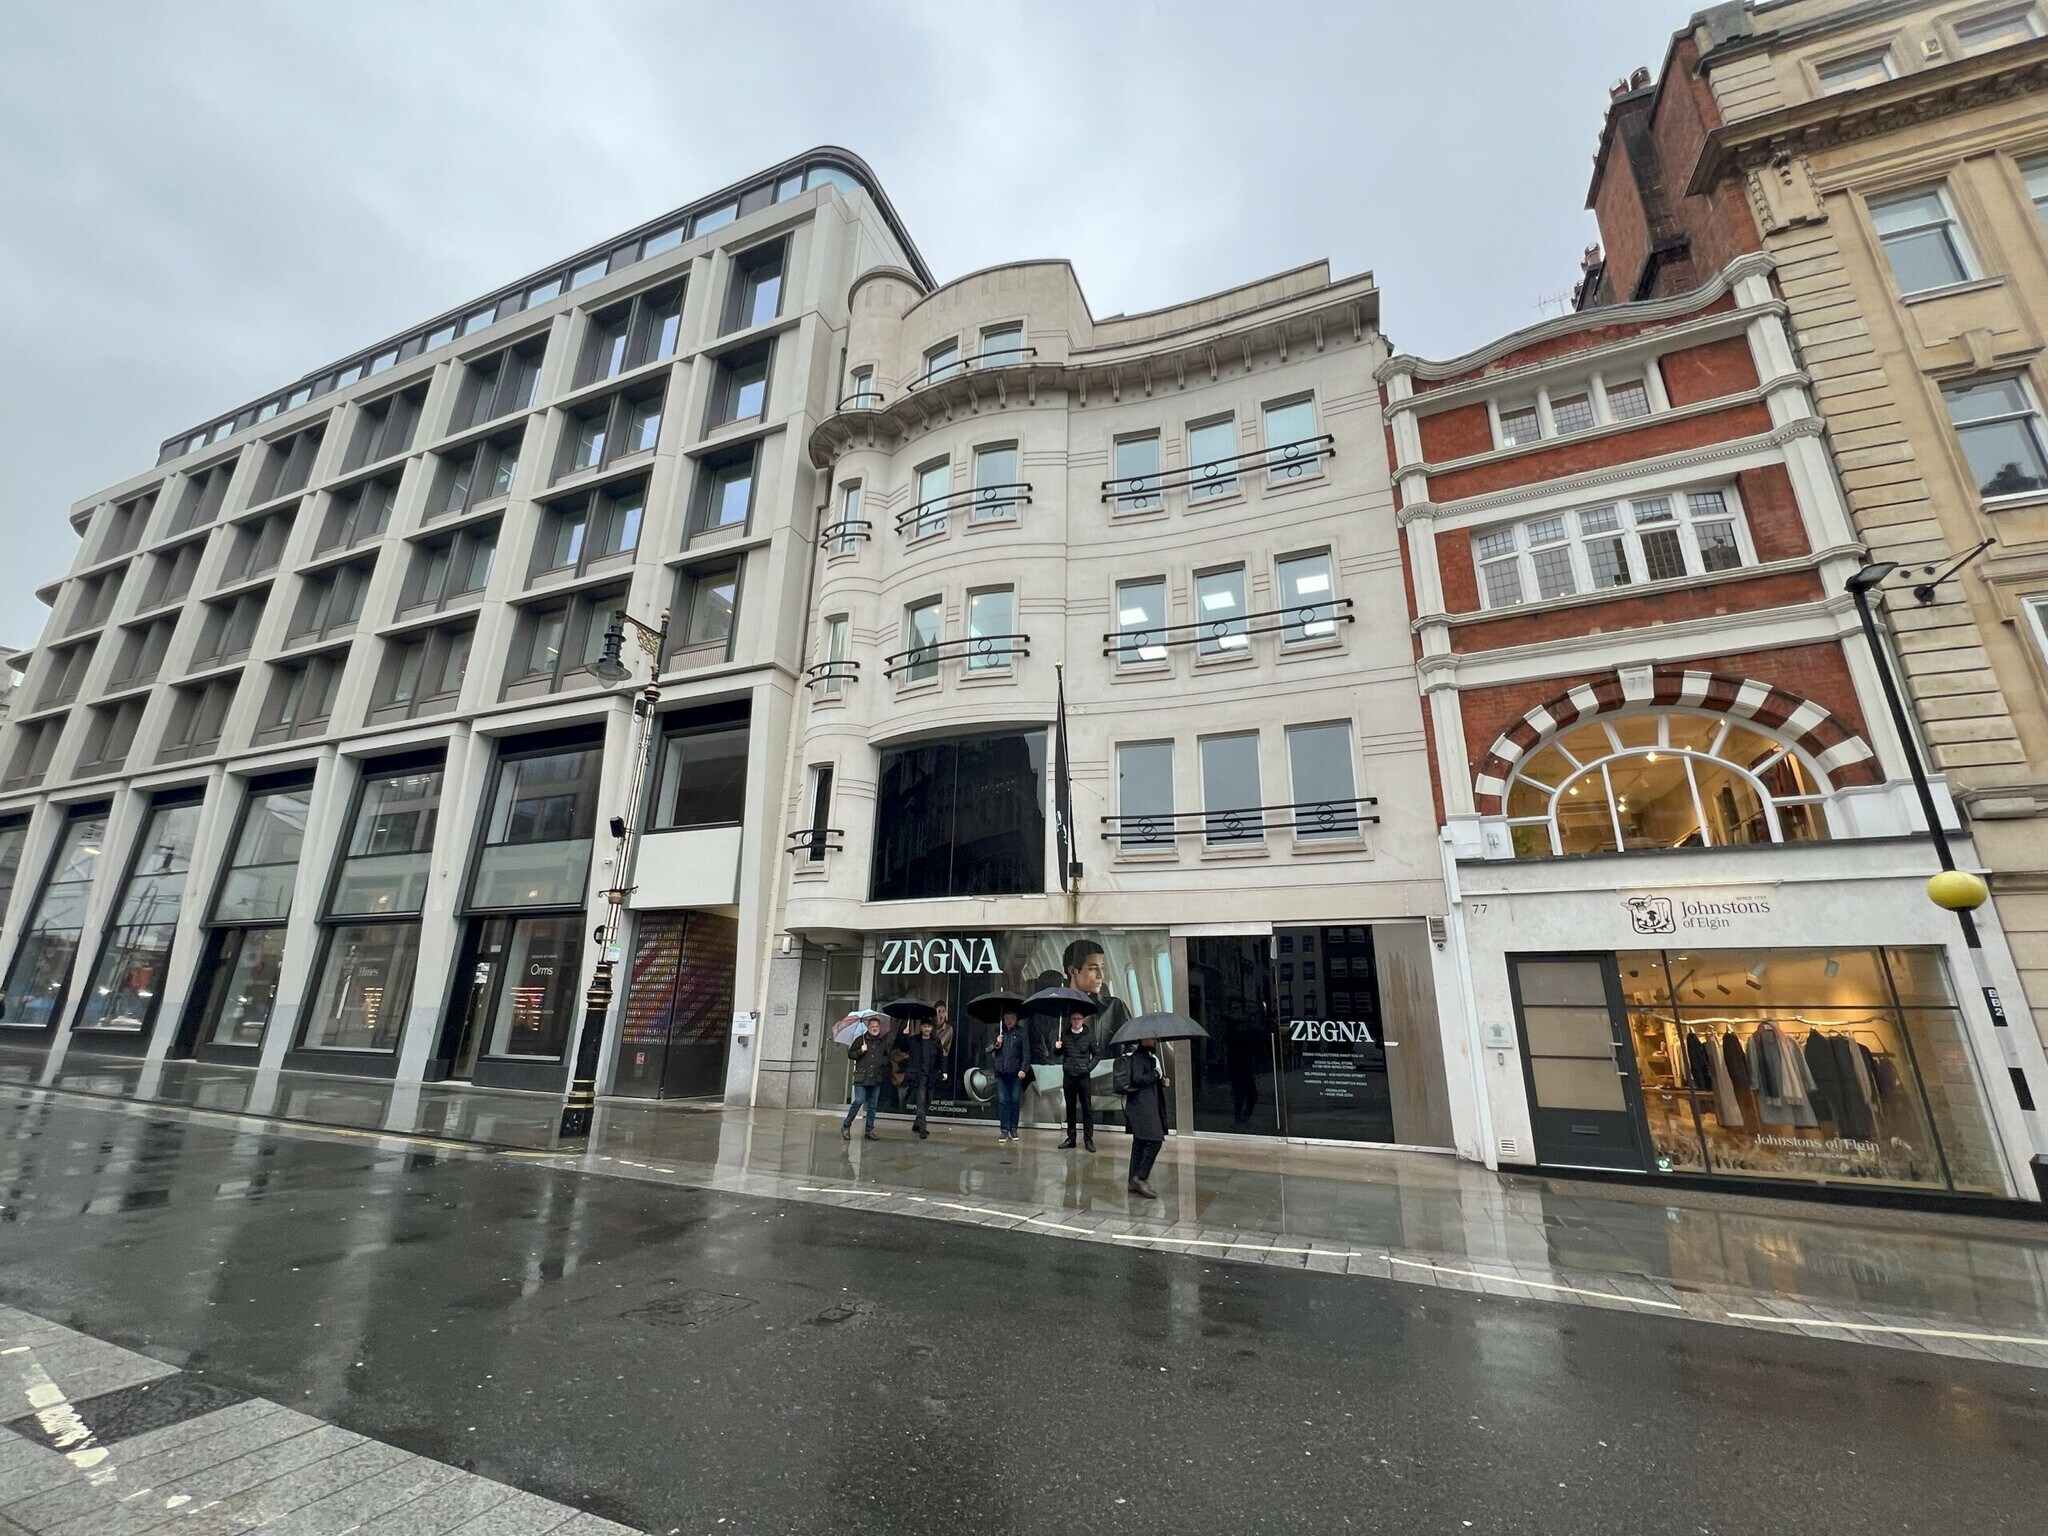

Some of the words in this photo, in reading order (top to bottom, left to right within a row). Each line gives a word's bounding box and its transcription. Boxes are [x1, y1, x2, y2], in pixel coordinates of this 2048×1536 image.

[1472, 904, 1488, 914] 77
[1681, 900, 1771, 919] Johnstons
[1682, 917, 1696, 929] of
[1697, 917, 1730, 930] Elgin
[880, 938, 1004, 975] ZEGNA
[531, 963, 554, 976] Orms
[1289, 1020, 1375, 1043] ZEGNA
[1754, 1133, 1822, 1148] Johnstons
[1826, 1138, 1840, 1149] of
[1844, 1138, 1880, 1153] Elgin
